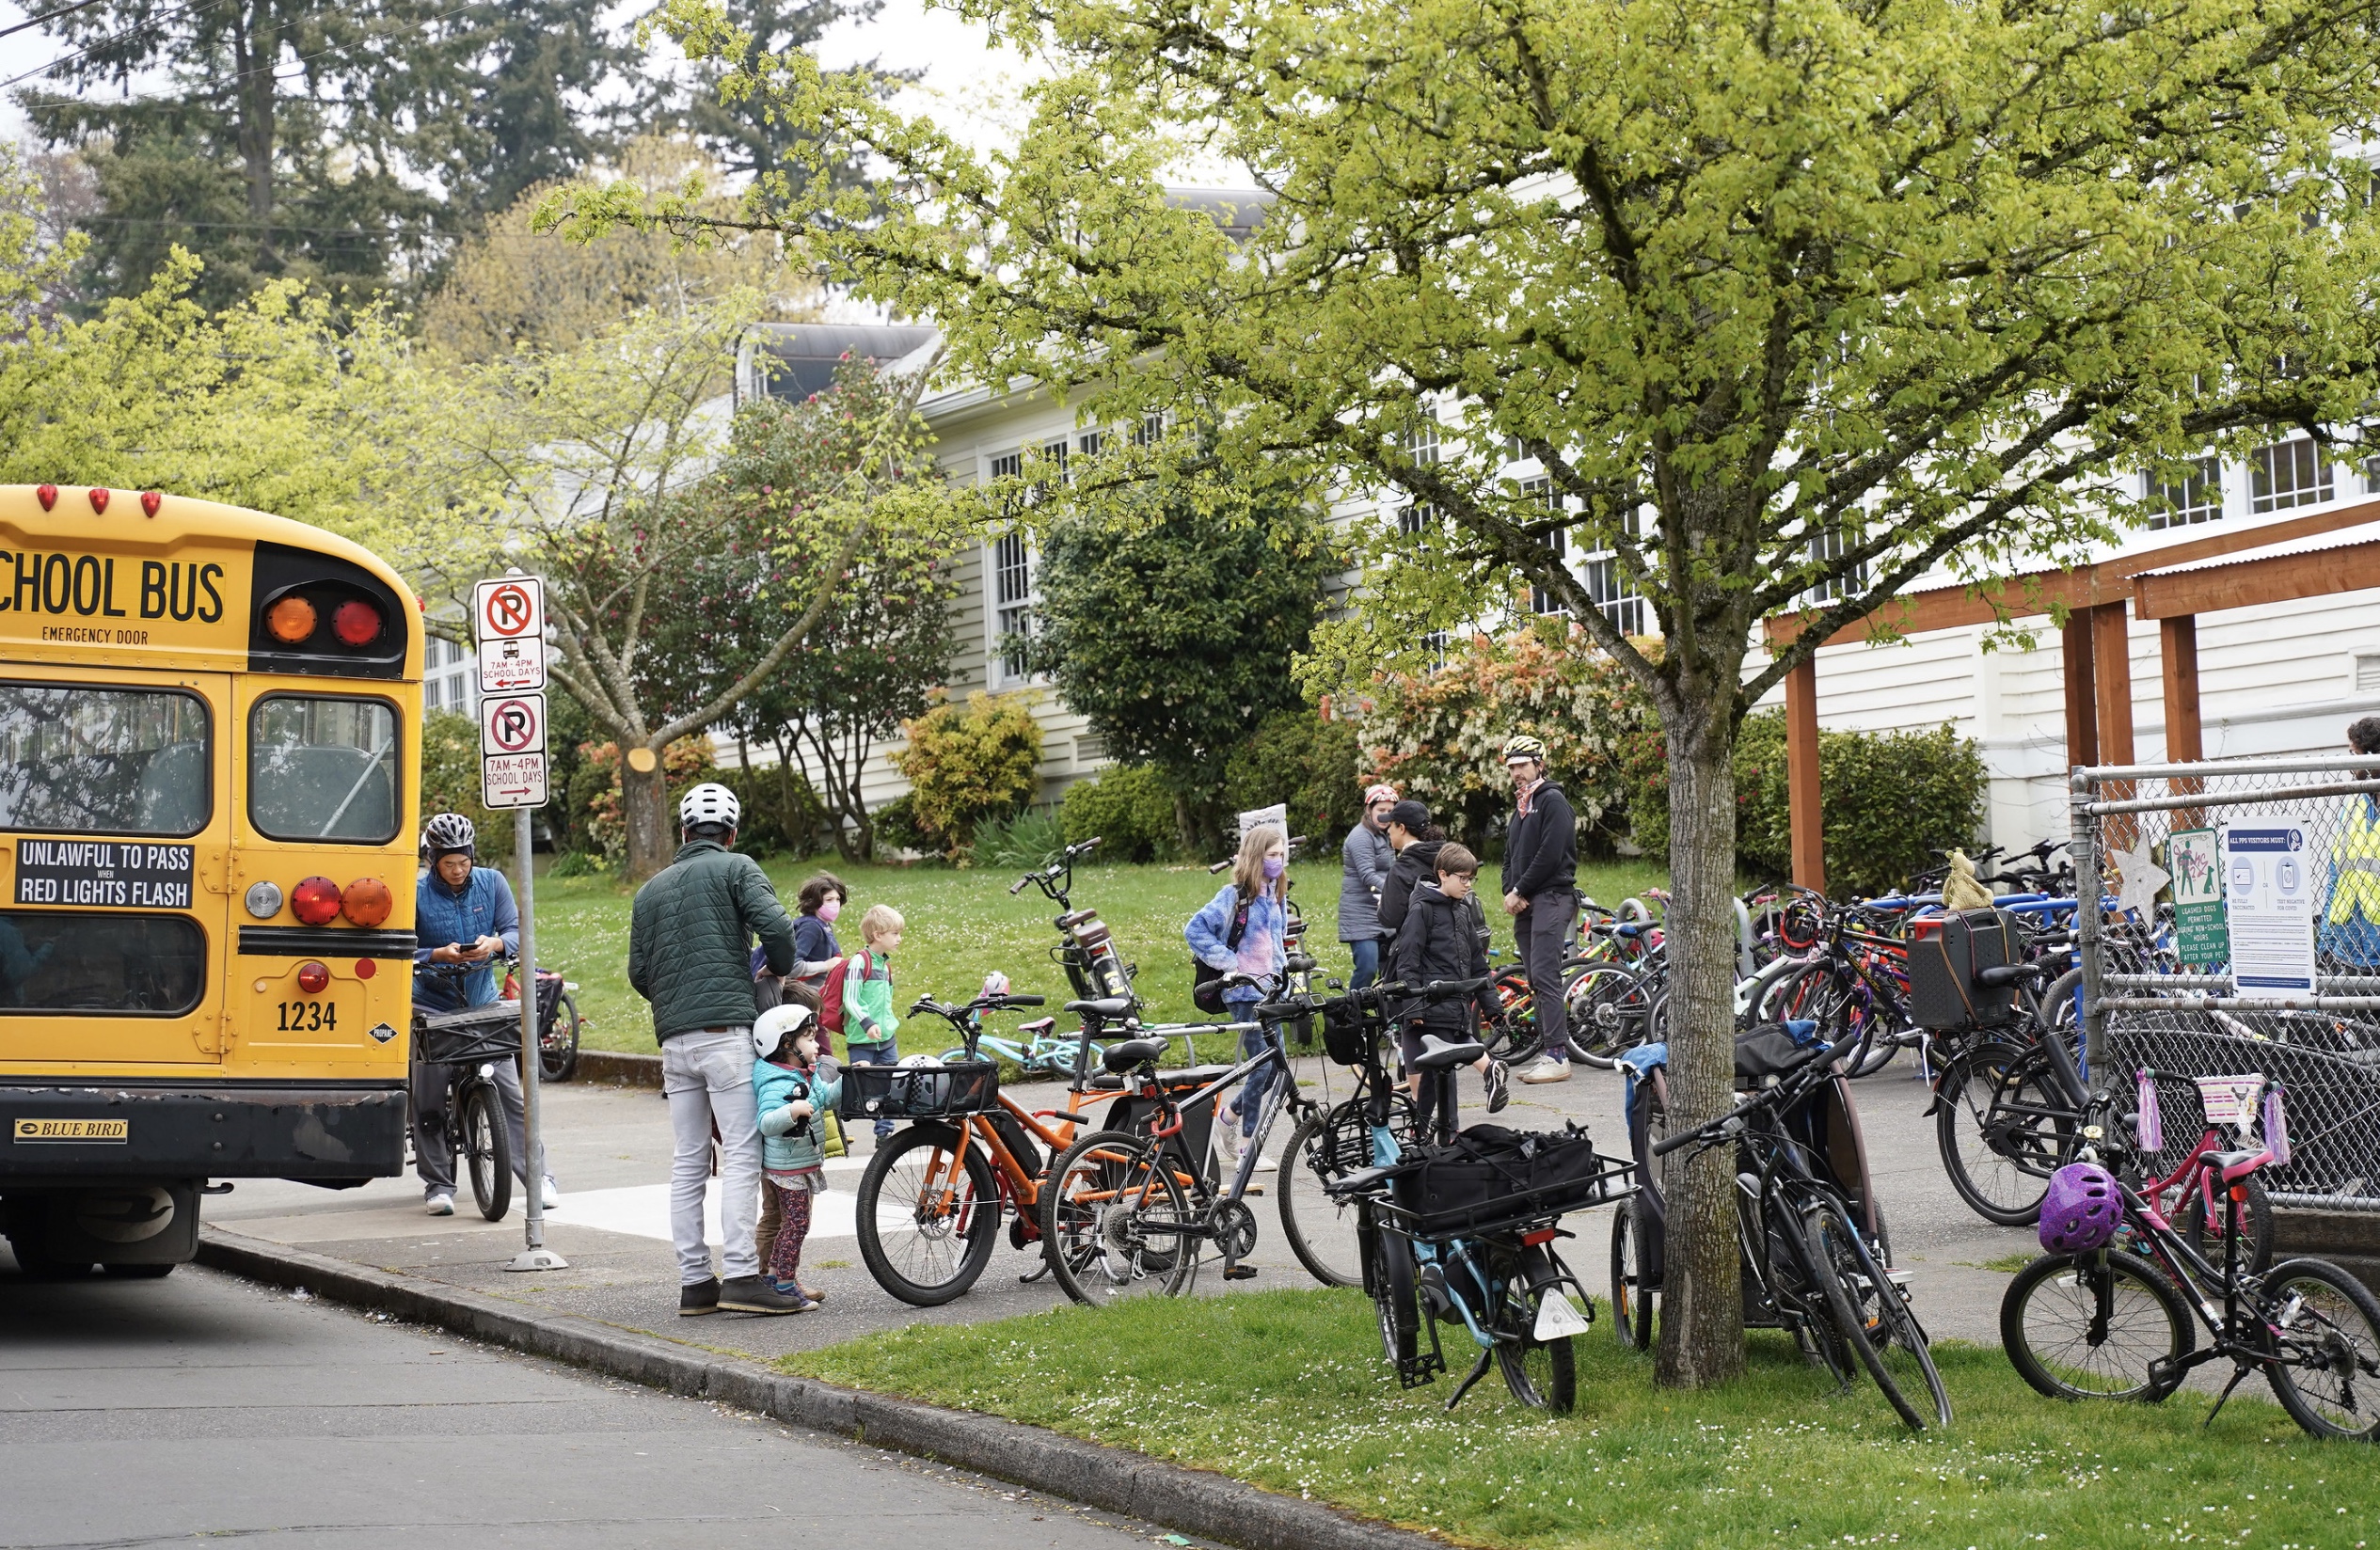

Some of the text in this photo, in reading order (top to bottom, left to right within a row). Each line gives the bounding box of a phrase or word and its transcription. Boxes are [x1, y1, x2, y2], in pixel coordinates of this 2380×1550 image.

[140, 561, 224, 624] BUS
[42, 626, 149, 645] EMERGENCY DOOR
[484, 667, 541, 678] SCHOOL DAYS
[486, 770, 543, 785] SCHOOL DAYS
[22, 841, 189, 871] UNLAWFUL TO PASS
[97, 869, 114, 878] WHEN
[21, 878, 187, 907] RED LIGHTS FLASH
[2182, 906, 2202, 915] LEASHED
[2187, 914, 2213, 923] PERMITTED
[2195, 923, 2225, 932] NON-SCHOOL
[2181, 943, 2198, 952] PLEASE
[2200, 942, 2216, 951] CLEAN
[2183, 953, 2198, 961] AFTER
[278, 1001, 337, 1031] 1234
[373, 1028, 392, 1037] PROPANE
[40, 1122, 123, 1136] BLUE BIRD
